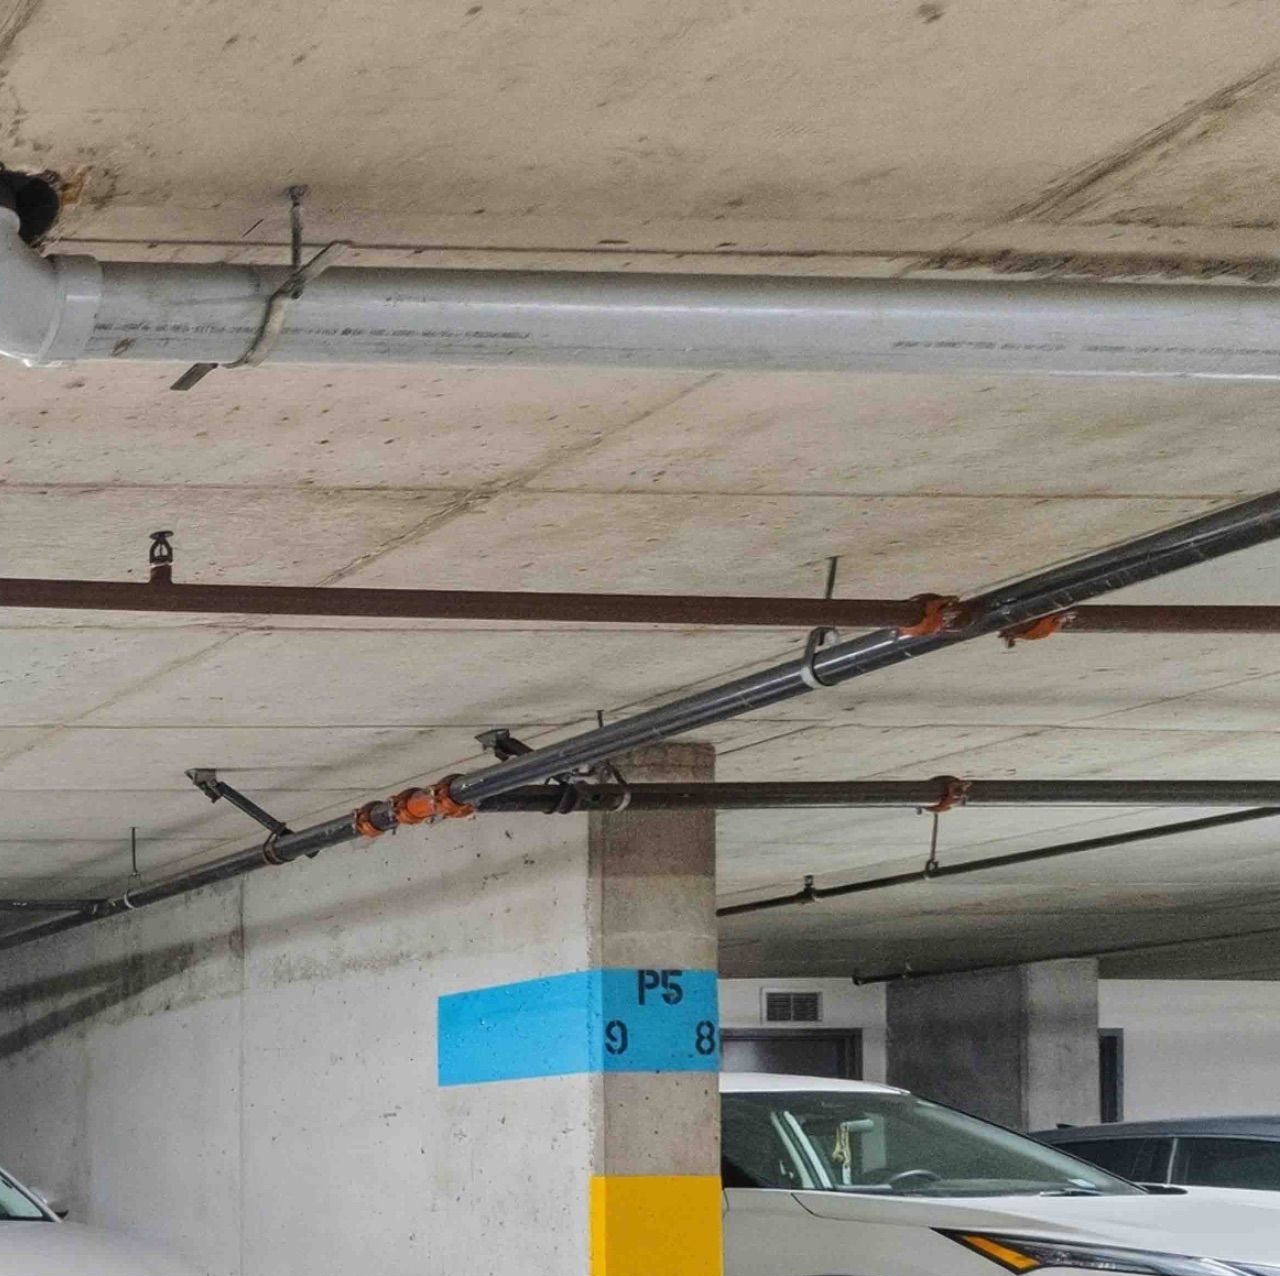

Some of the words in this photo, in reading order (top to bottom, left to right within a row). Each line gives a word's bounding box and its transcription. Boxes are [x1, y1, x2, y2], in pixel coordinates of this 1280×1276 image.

[637, 969, 683, 1006] P5
[605, 1020, 628, 1055] 9
[695, 1020, 716, 1055] 8
